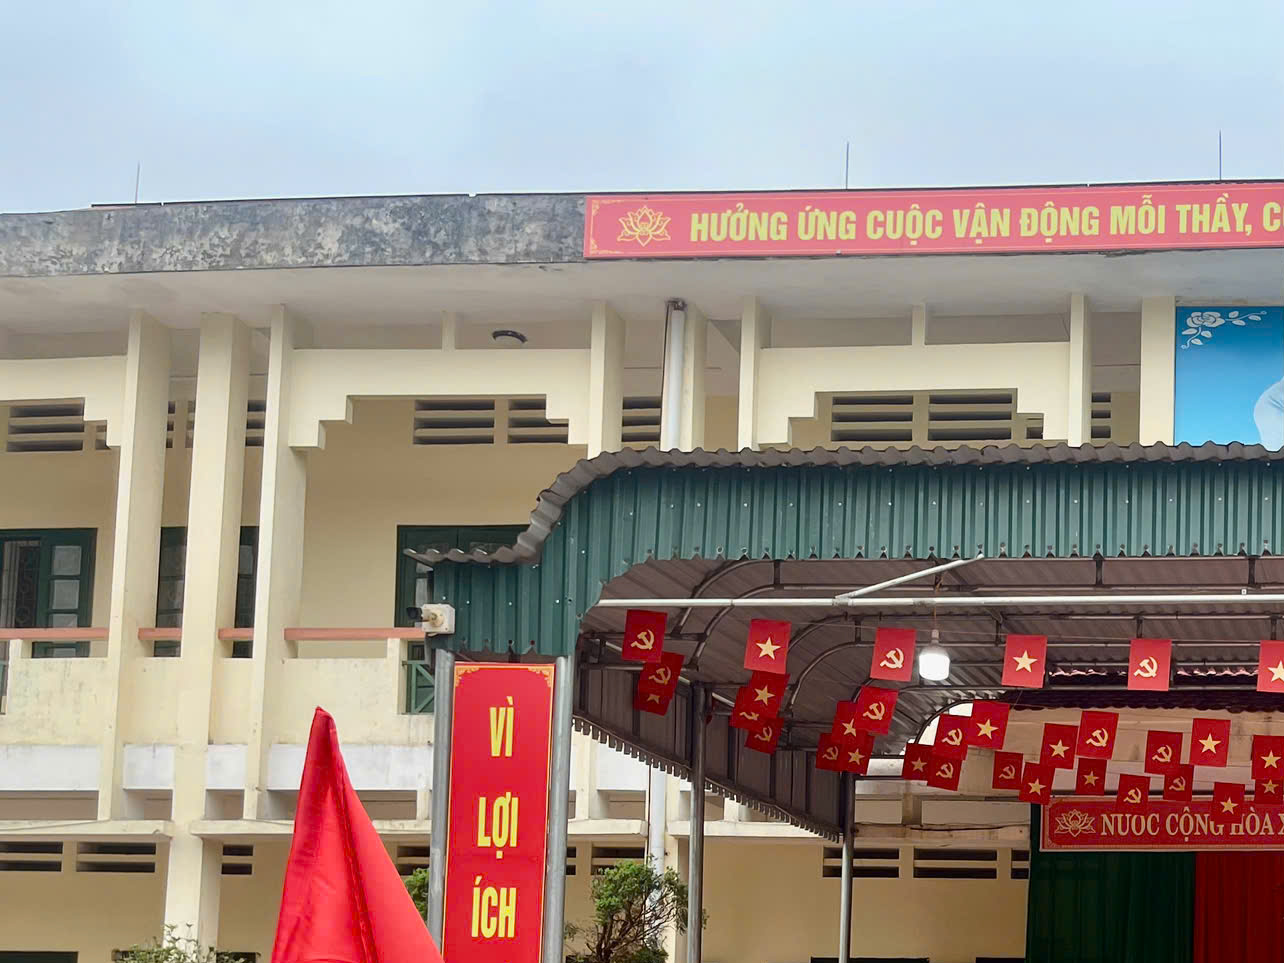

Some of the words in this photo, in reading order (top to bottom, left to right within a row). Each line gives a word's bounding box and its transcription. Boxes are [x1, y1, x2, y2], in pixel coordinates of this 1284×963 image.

[690, 202, 788, 242] HƯỞNG
[797, 206, 857, 240] ỨNG
[866, 203, 943, 245] CUỘC
[953, 203, 1011, 245] VẬN
[1019, 200, 1100, 244] ĐỘNG
[1109, 194, 1166, 235] MỖI
[1175, 193, 1253, 236] THẦY,
[489, 696, 514, 757] VÌ
[477, 791, 519, 859] LỢI
[471, 875, 517, 938] ÍCH
